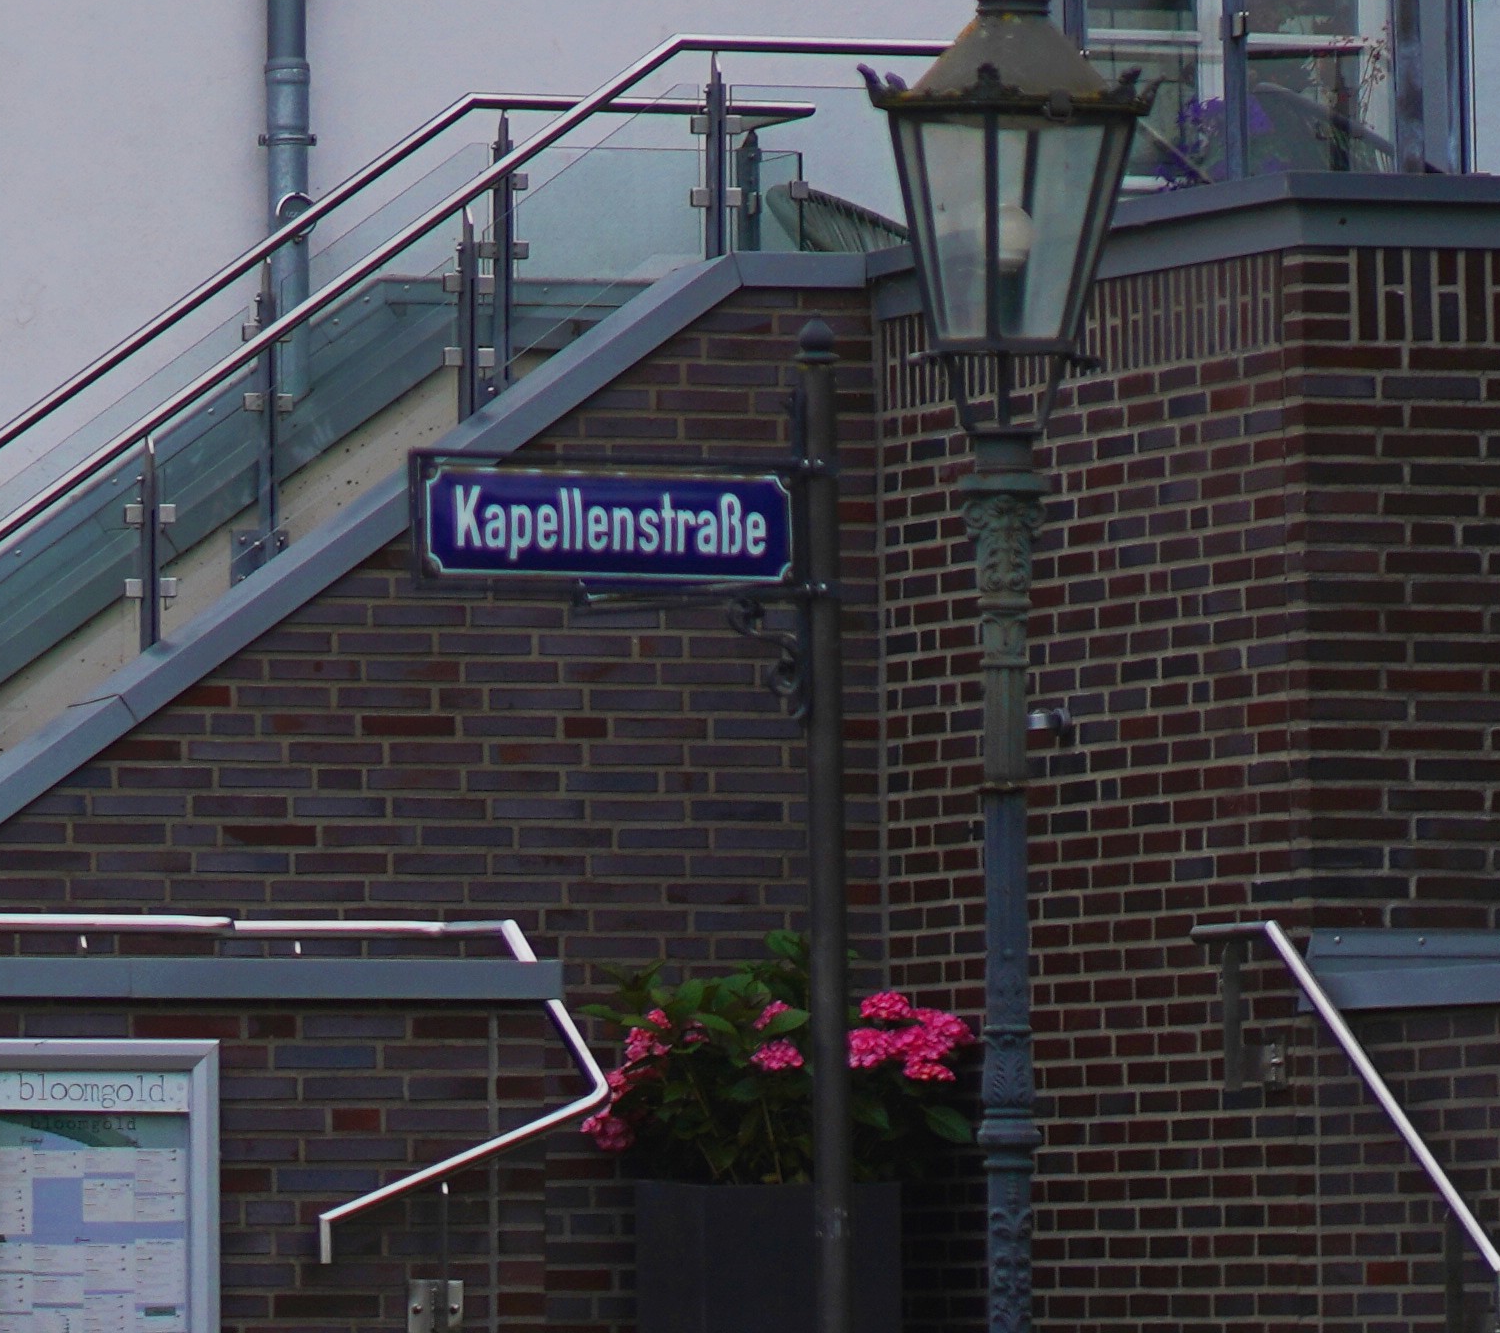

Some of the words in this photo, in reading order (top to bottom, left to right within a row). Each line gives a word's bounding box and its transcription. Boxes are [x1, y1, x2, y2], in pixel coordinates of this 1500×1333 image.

[455, 484, 767, 560] Kapellenstraße
[18, 1073, 166, 1109] bloomgold
[30, 1117, 136, 1132] bloomgold
